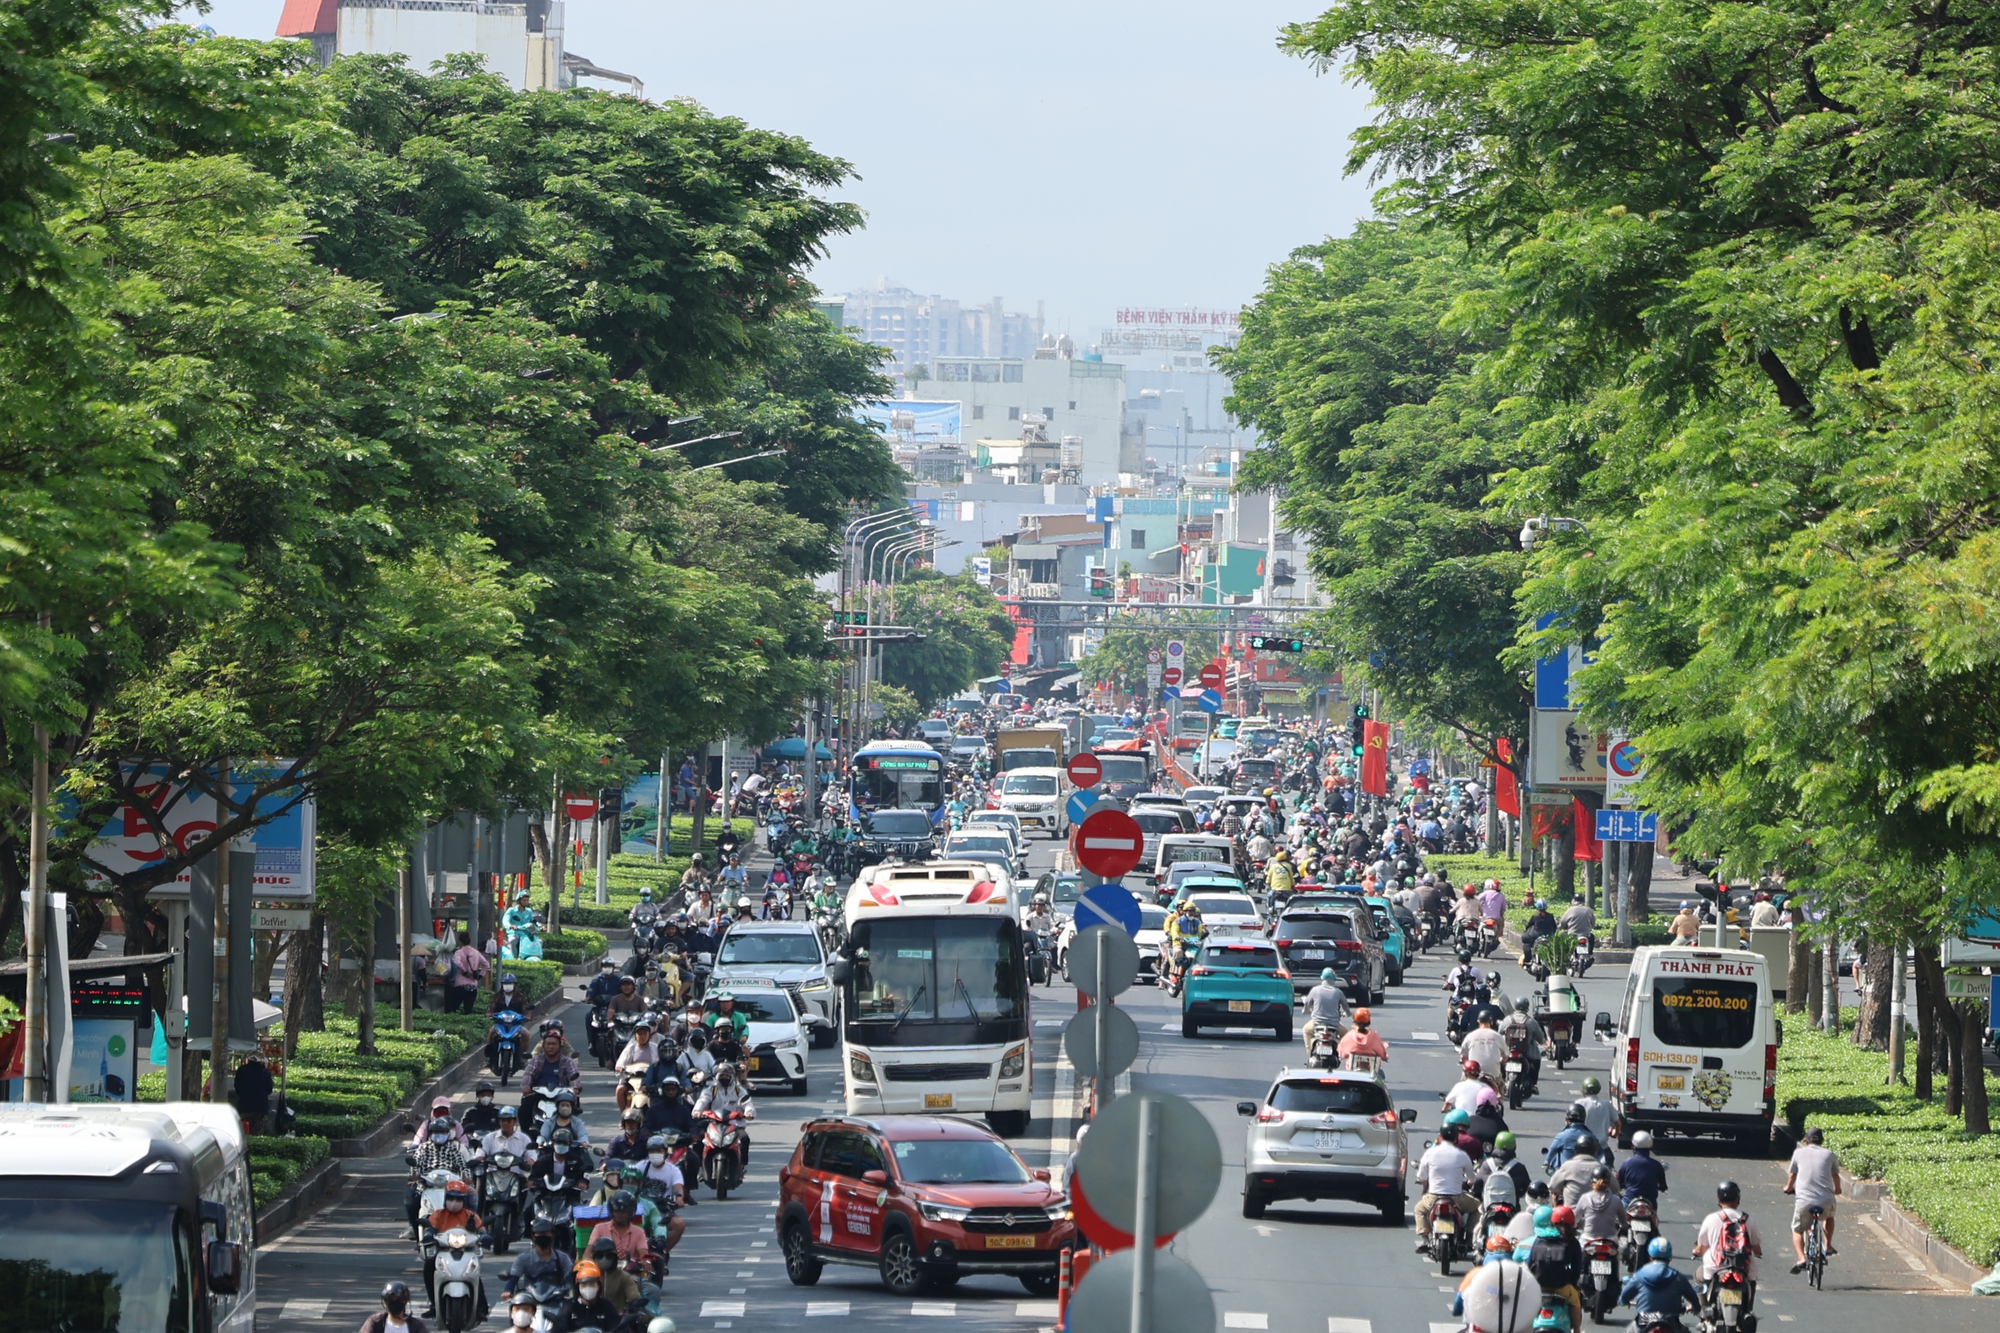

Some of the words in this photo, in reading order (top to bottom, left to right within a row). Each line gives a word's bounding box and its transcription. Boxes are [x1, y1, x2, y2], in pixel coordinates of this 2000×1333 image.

[1116, 308, 1145, 325] BỆNH
[1148, 309, 1172, 326] VIỆN
[1176, 307, 1207, 324] THẨM
[253, 874, 291, 885] HÚC
[1661, 958, 1711, 974] THÀNH
[1715, 960, 1754, 976] PHÁT
[1662, 994, 1748, 1010] 0972.200.200
[77, 1050, 99, 1059] Minh
[1643, 1051, 1698, 1065] 60H-139.09
[847, 1221, 871, 1236] GENERALI
